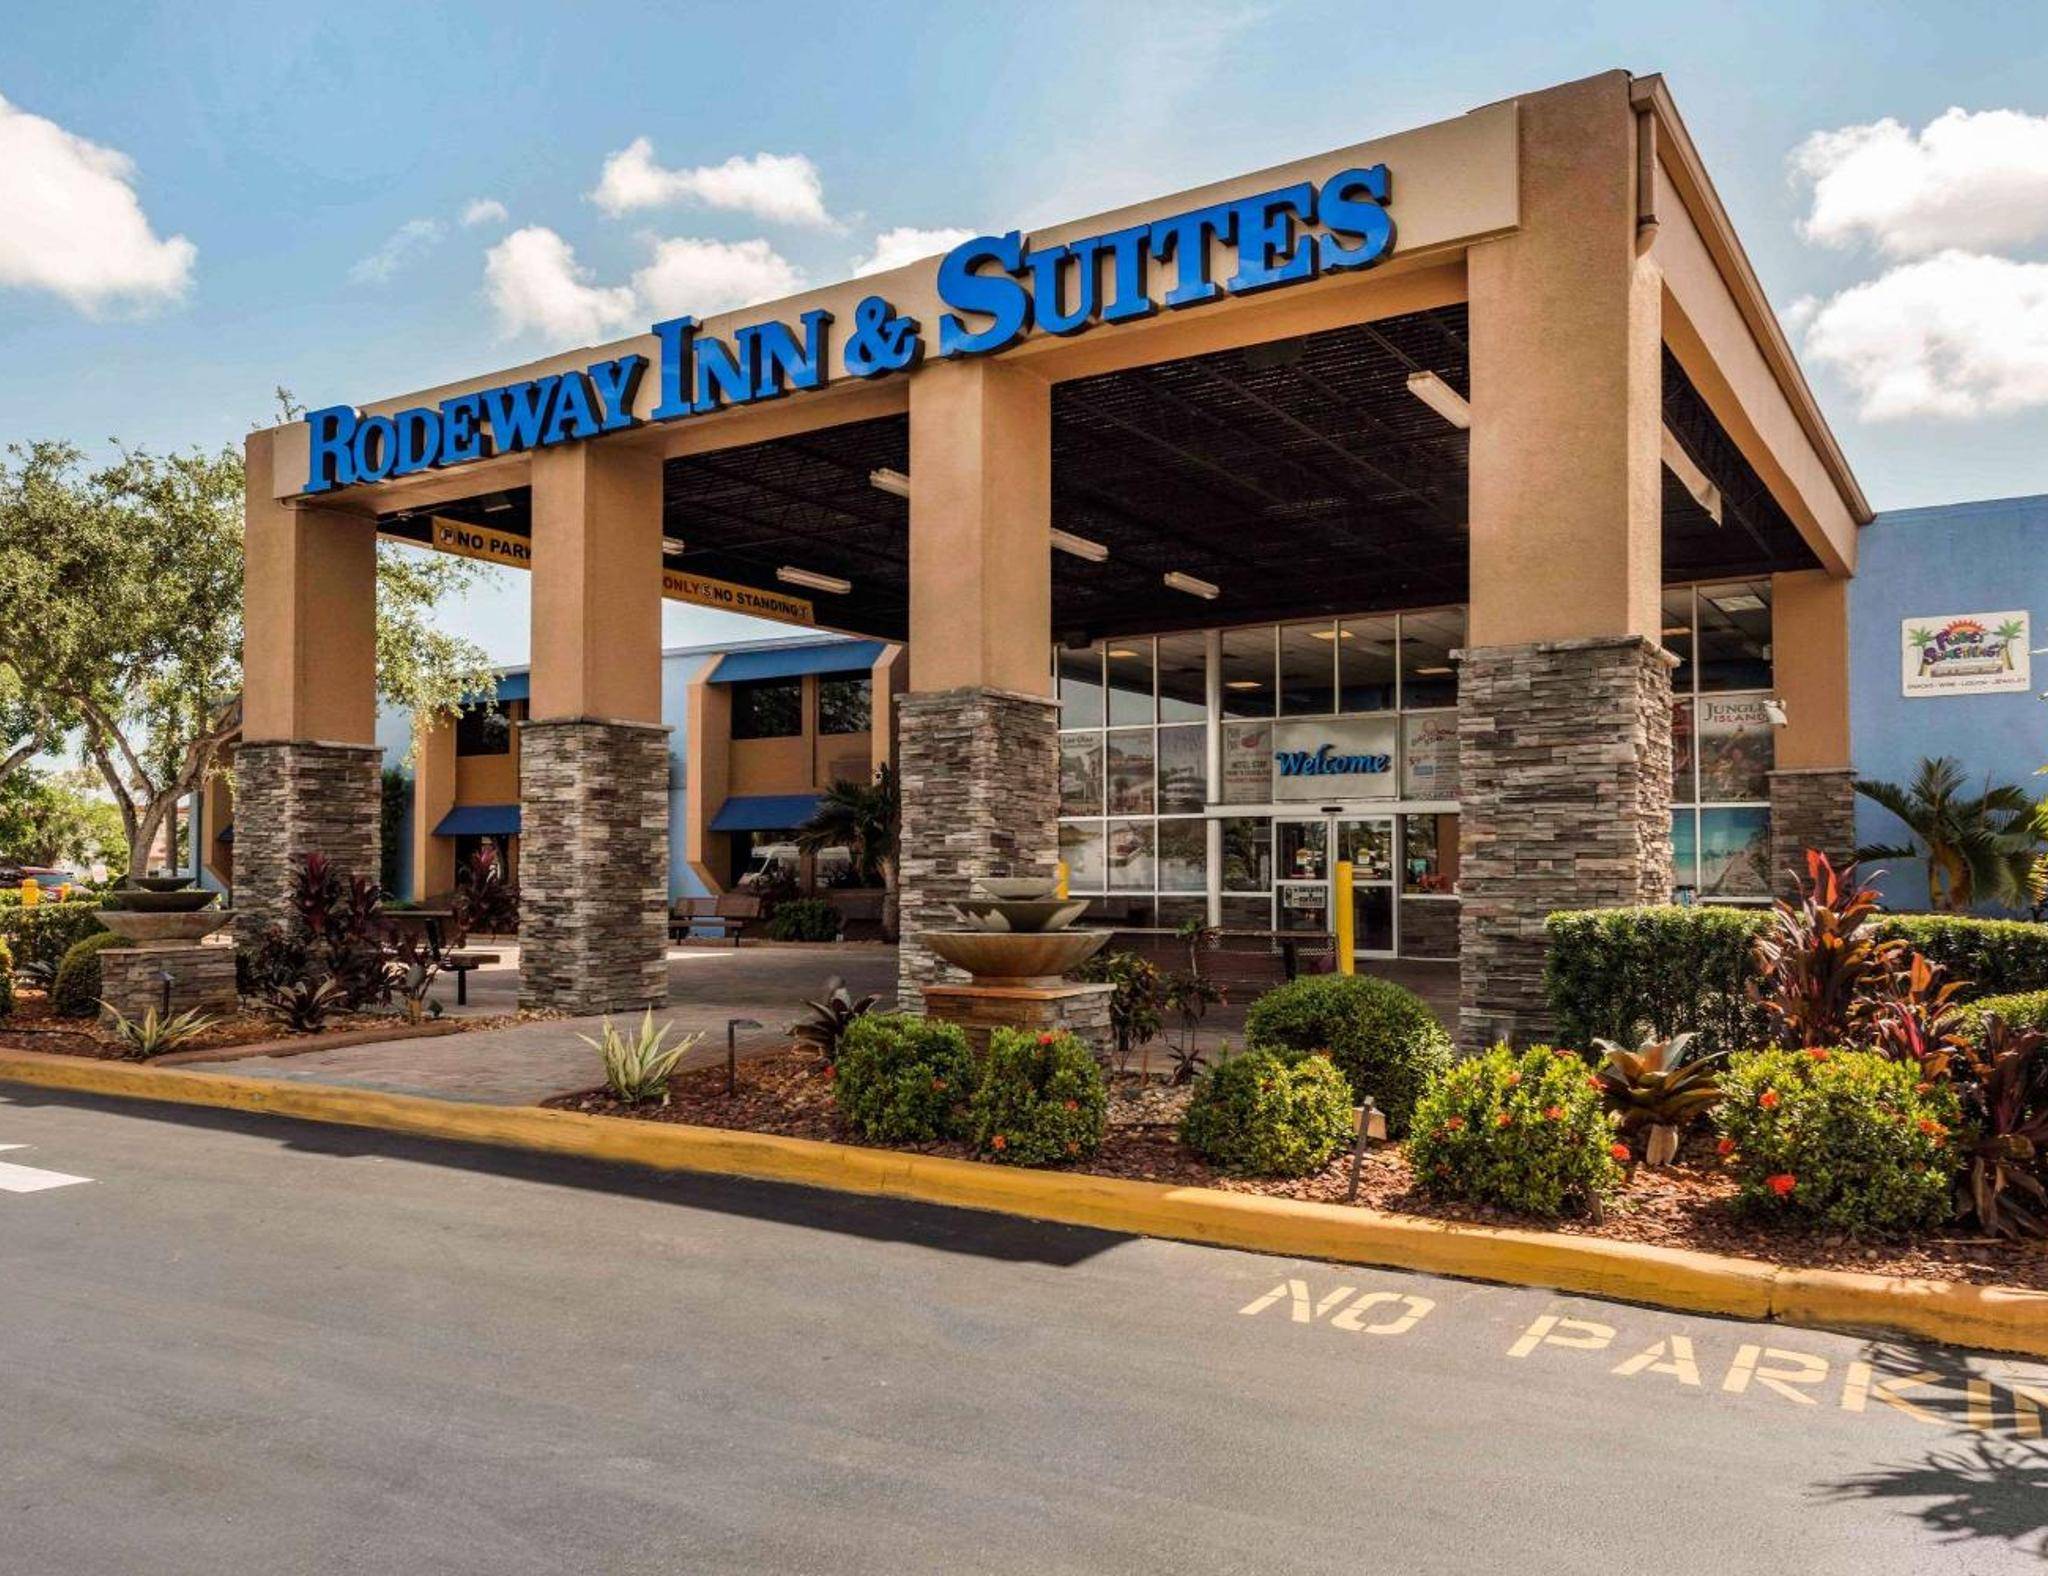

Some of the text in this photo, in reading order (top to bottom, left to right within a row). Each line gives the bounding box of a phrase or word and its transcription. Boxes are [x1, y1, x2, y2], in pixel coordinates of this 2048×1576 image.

[303, 163, 1398, 493] RODEWAY INN & SUITES
[458, 531, 484, 549] NO
[663, 576, 700, 595] ONLY
[714, 587, 733, 602] NO
[736, 592, 799, 617] STANDING
[1275, 744, 1392, 776] Welcome
[1238, 1279, 1436, 1335] NO
